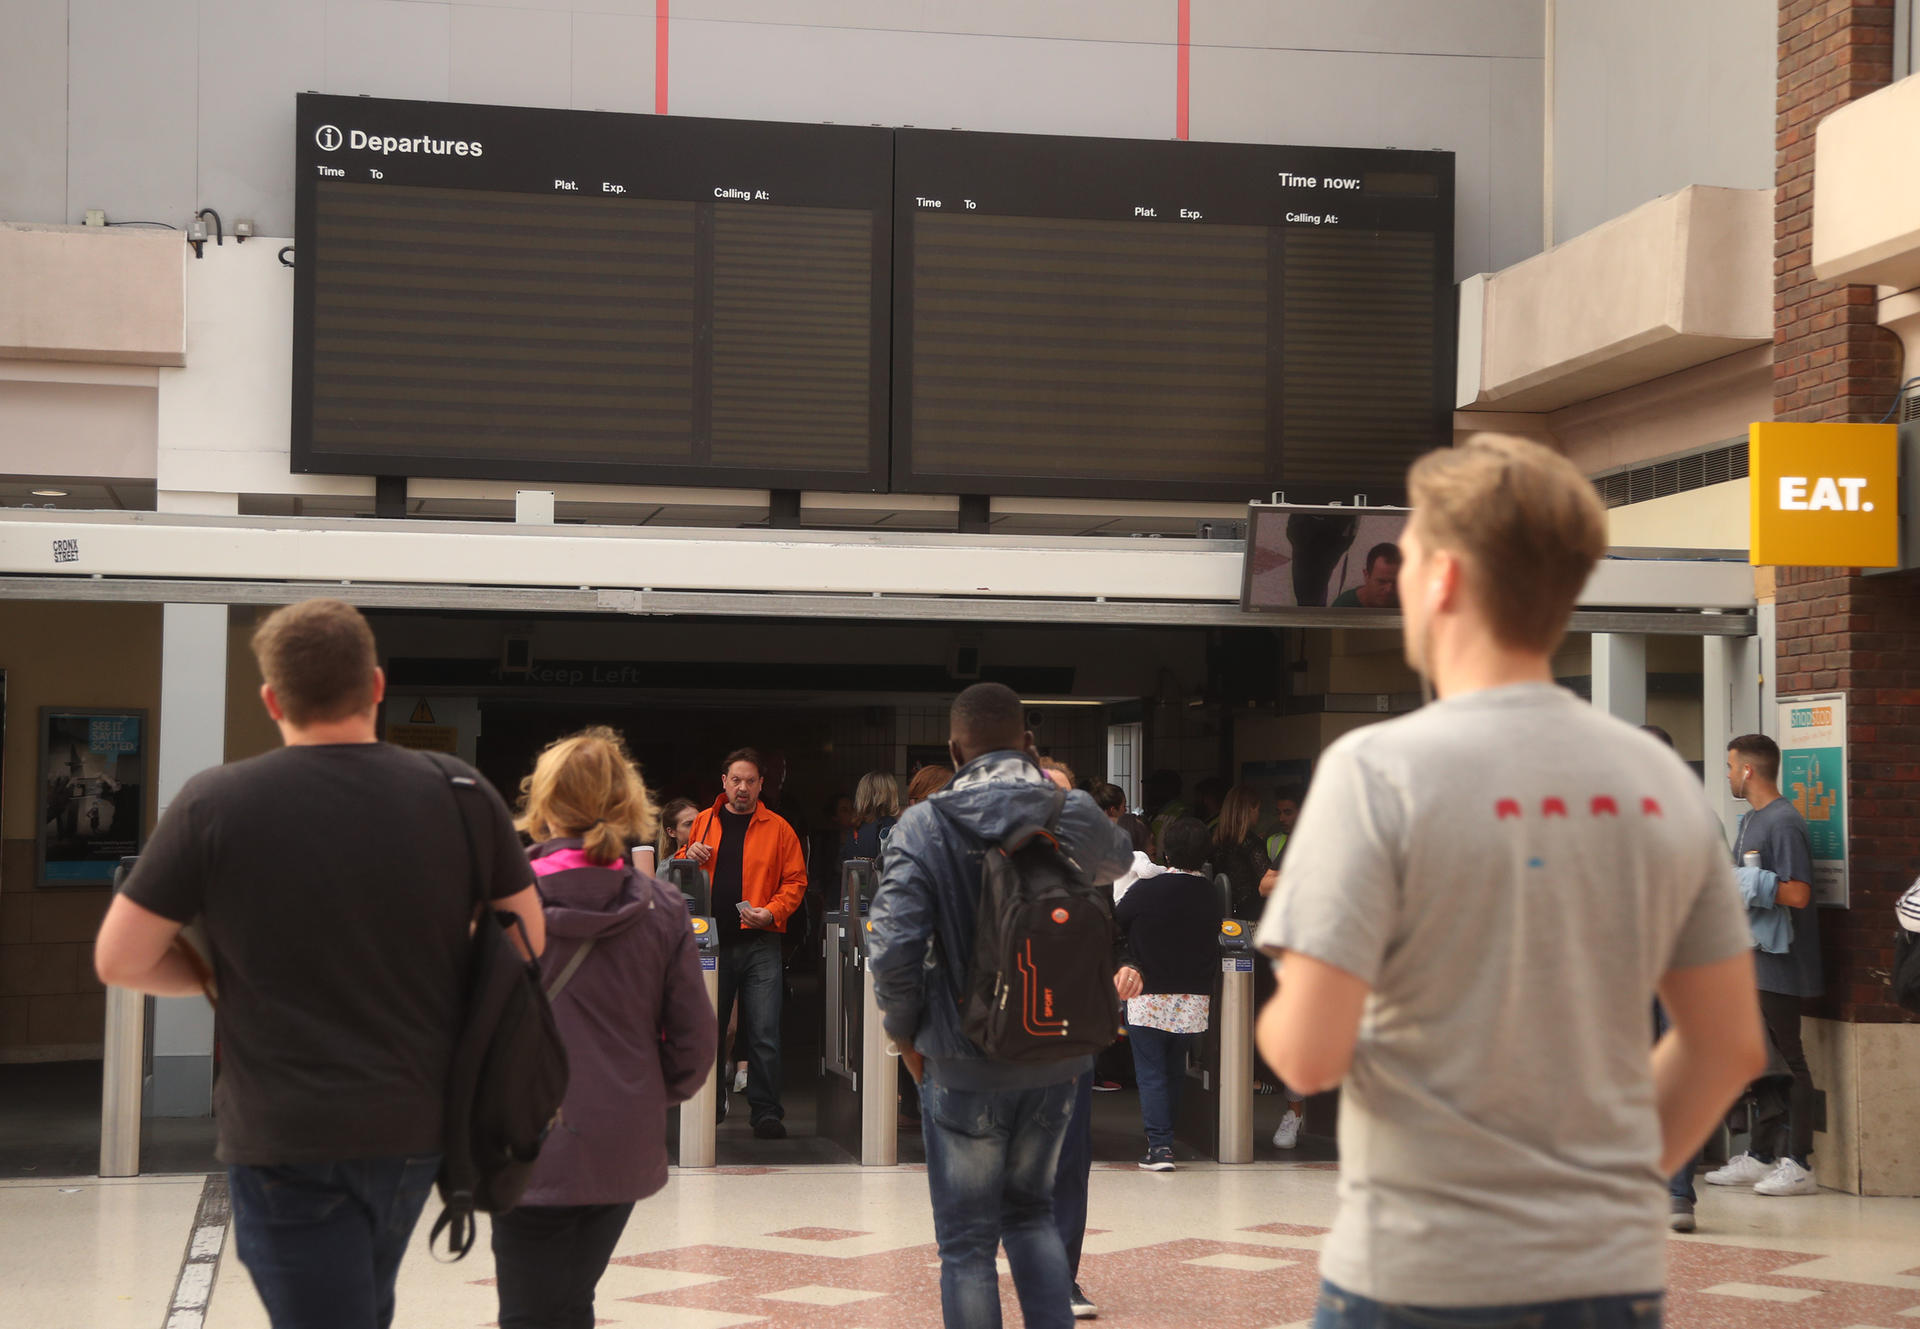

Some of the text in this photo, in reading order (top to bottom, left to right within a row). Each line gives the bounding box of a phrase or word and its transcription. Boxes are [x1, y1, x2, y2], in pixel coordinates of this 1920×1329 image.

[350, 130, 483, 157] Departures
[317, 165, 345, 178] Time
[370, 168, 384, 180] To
[554, 179, 579, 191] Plat.
[1278, 172, 1361, 190] Time now:
[602, 182, 627, 195] Exp.
[714, 187, 770, 201] Calling At:
[916, 197, 942, 208] Time
[963, 199, 976, 210] To
[1134, 206, 1157, 217] Plat.
[1179, 208, 1203, 221] Exp.
[1285, 212, 1339, 225] Calling At:
[1779, 476, 1874, 512] EAT.
[53, 539, 79, 551] CRONX
[54, 550, 79, 562] STREET
[525, 664, 641, 686] Keep Left
[91, 720, 125, 731] SEE IT.
[91, 731, 125, 741] SAY IT.
[91, 741, 137, 752] SORTED.
[1043, 988, 1053, 1018] SPORT
